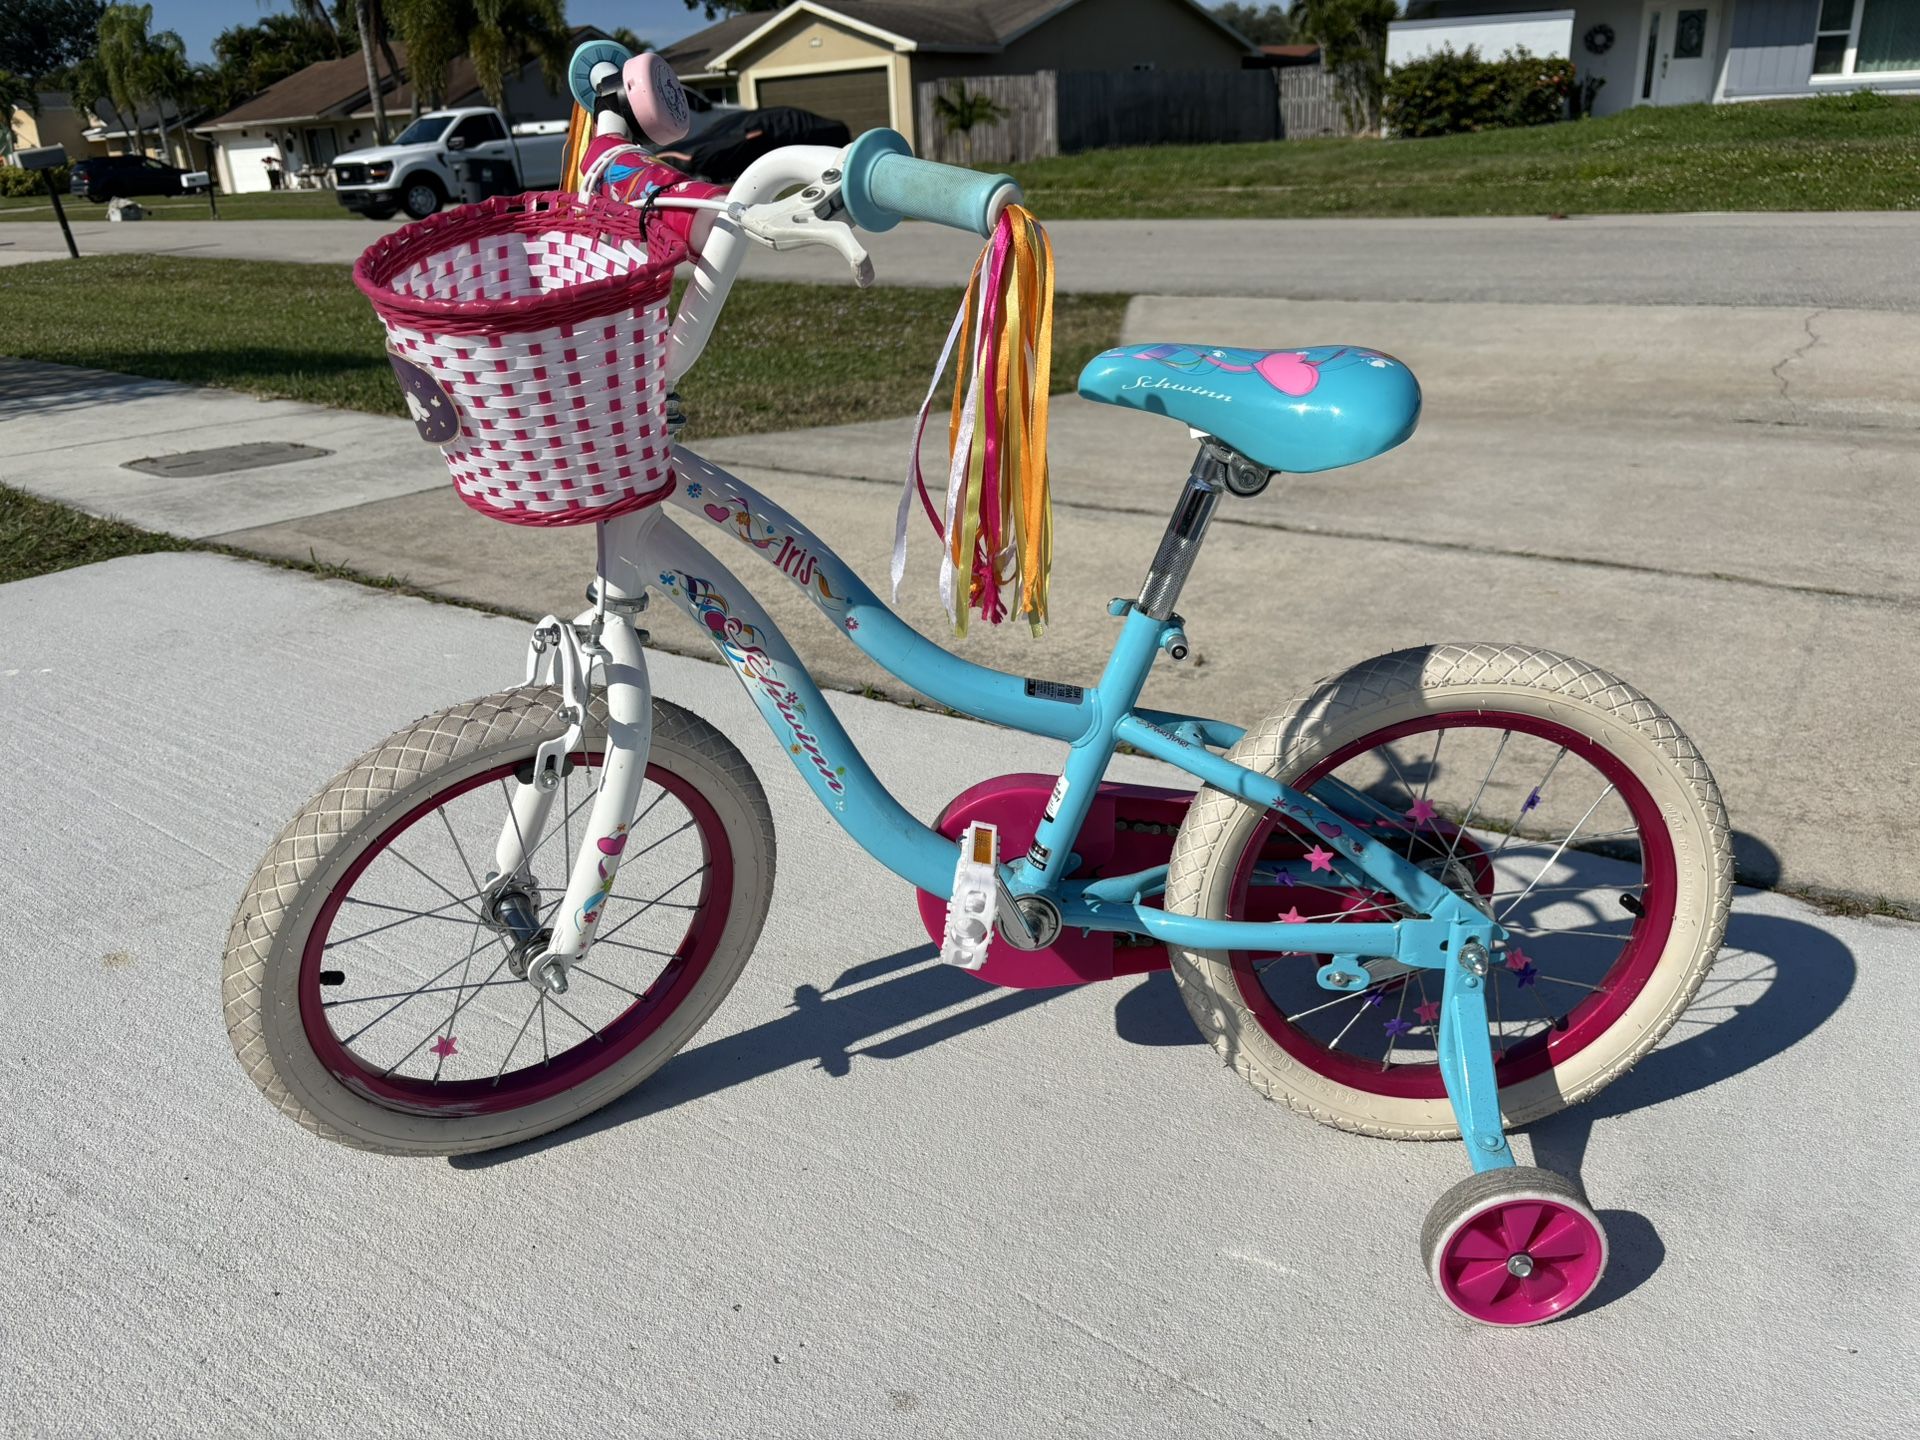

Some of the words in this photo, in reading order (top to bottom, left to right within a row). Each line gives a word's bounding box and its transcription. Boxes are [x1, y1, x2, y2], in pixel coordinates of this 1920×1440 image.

[1121, 375, 1233, 402] Schwinn
[773, 535, 818, 586] Iris
[723, 617, 845, 796] Schwinn
